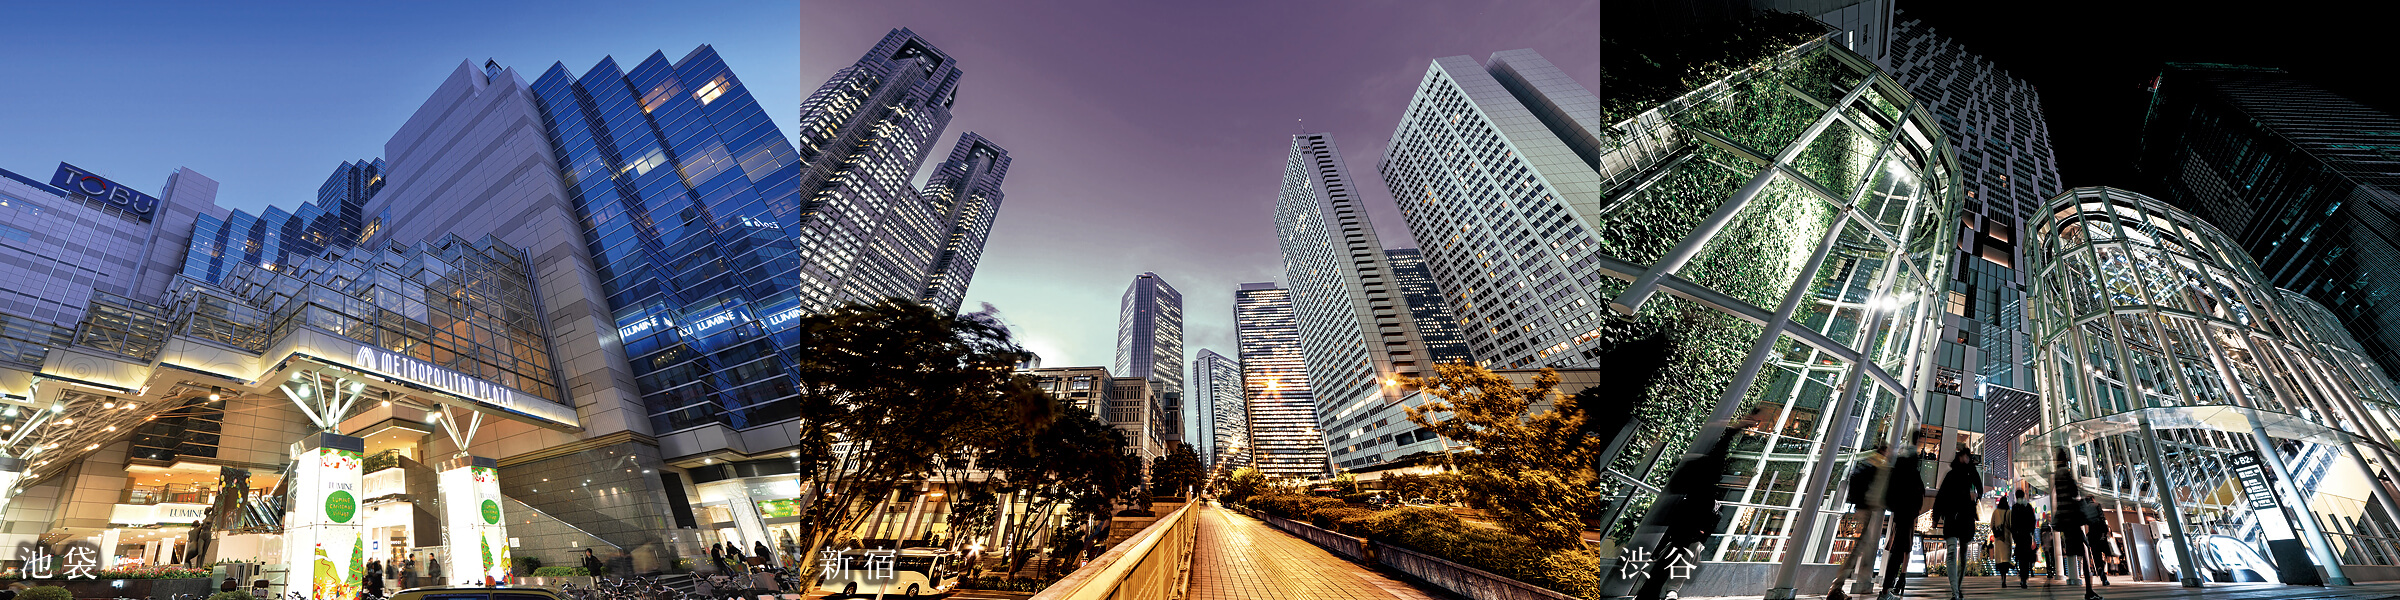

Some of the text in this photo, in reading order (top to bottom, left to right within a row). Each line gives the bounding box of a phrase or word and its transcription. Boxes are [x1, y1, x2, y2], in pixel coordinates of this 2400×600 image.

[65, 166, 153, 214] TOBU
[623, 317, 659, 337] LUMINE
[697, 309, 736, 331] LUMINE
[381, 352, 513, 406] METROPOLITAN PLAZA
[328, 481, 353, 491] LUMINE
[169, 508, 203, 518] LUMINE
